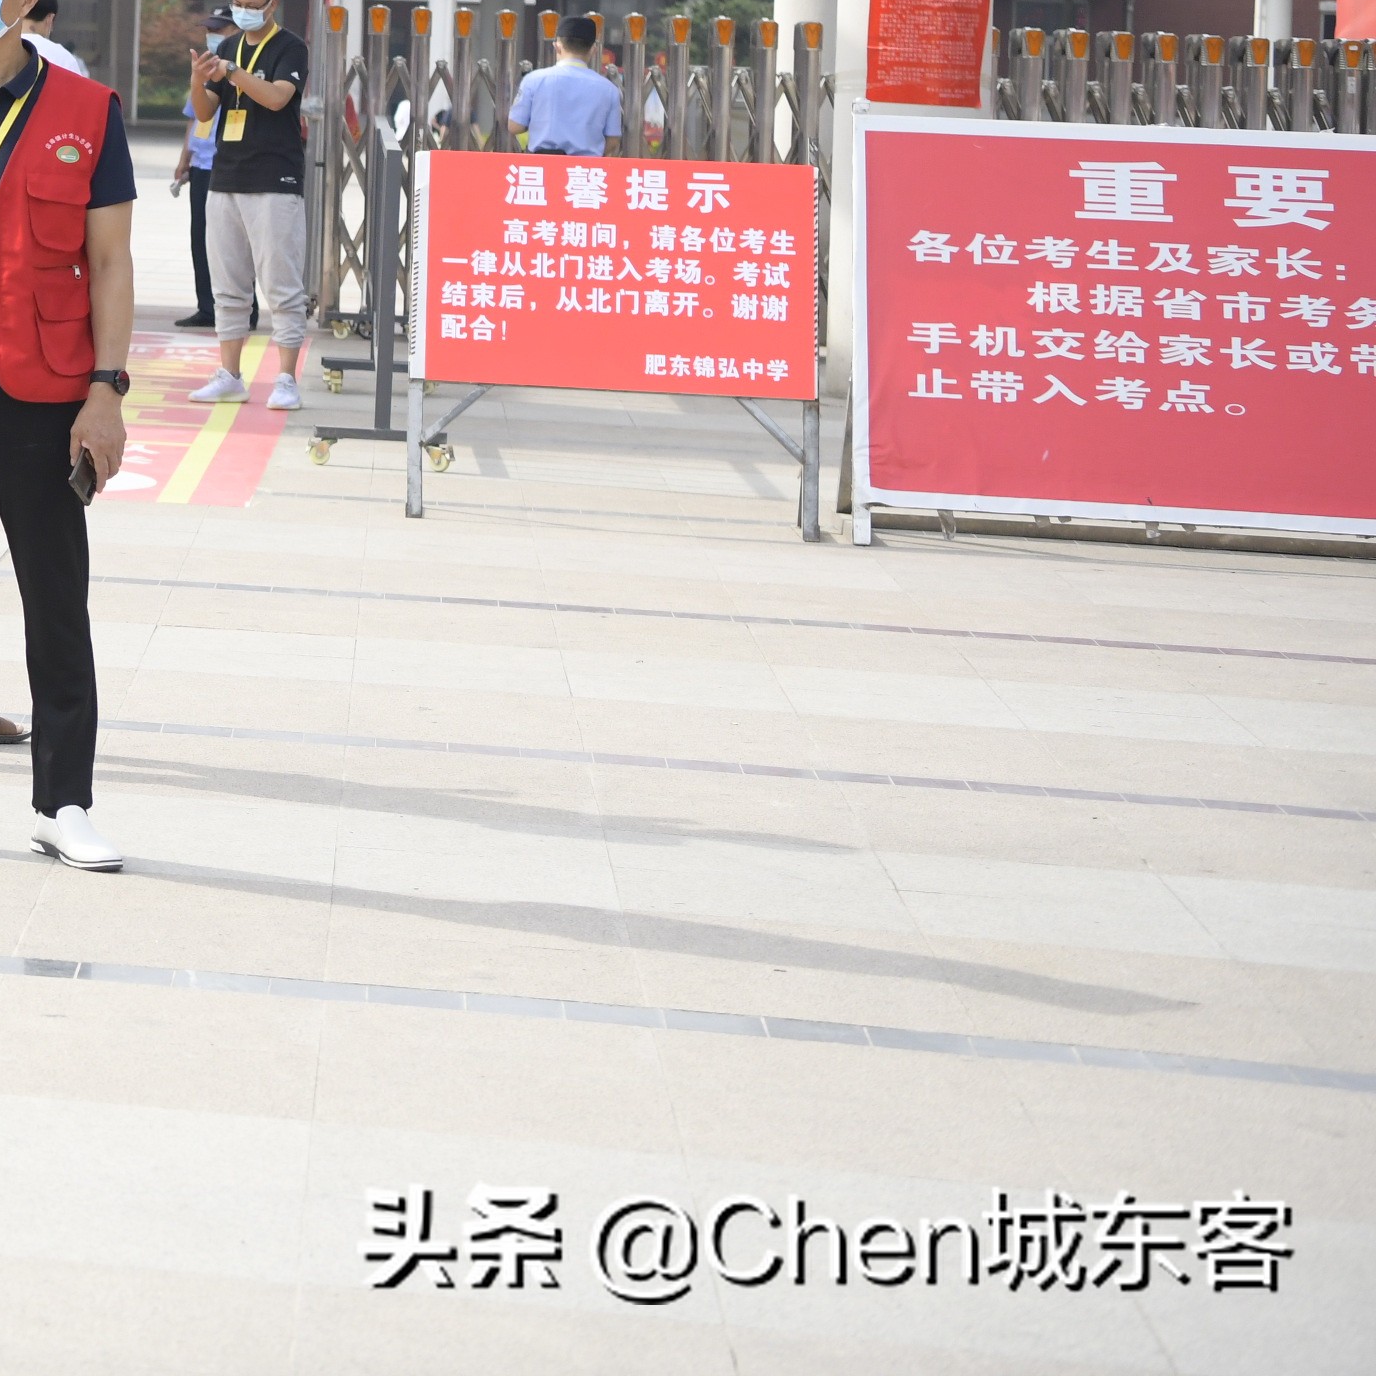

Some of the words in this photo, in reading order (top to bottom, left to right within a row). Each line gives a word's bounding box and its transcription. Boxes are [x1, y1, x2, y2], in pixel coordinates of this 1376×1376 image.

[504, 164, 731, 214] 温馨提示
[1068, 160, 1335, 231] 重要
[503, 218, 797, 257] 高考期间，请各位考生
[906, 229, 1347, 282] 各位考生及家长：
[442, 250, 791, 289] 一律从北门进入考场。考试
[441, 281, 789, 322] 结束后，从北门离开。谢谢
[644, 354, 789, 382] 肥东锦弘中学
[908, 367, 1246, 416] 止带入考点。
